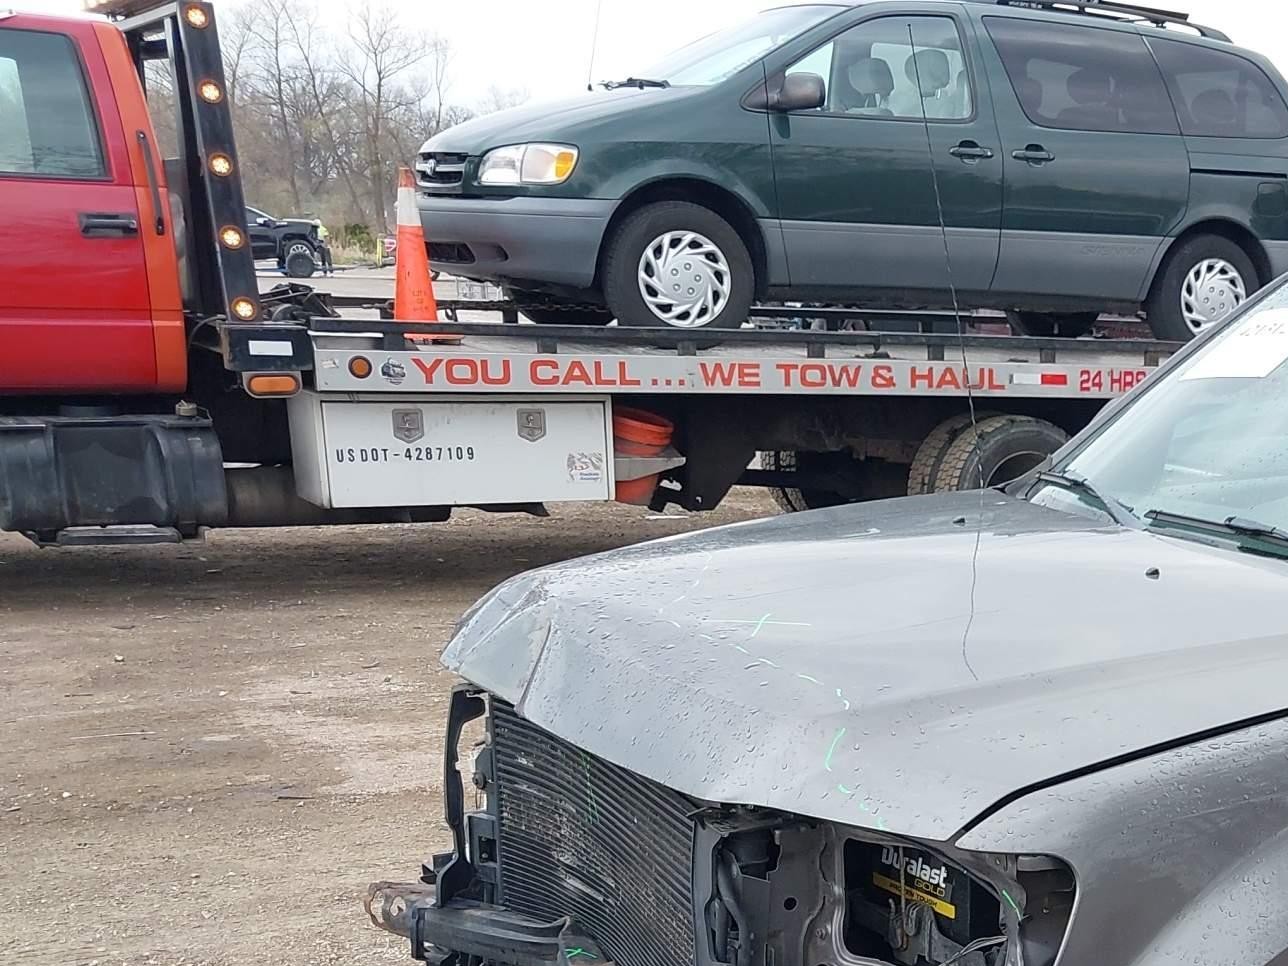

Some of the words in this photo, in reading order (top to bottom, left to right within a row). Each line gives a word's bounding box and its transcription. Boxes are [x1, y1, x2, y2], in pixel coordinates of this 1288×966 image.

[411, 357, 512, 385] YOU
[699, 362, 761, 388] WE
[775, 363, 862, 388] TOW
[871, 365, 896, 389] &
[910, 366, 1006, 391] HAUL
[1079, 369, 1103, 392] 24
[914, 878, 946, 898] GOLD
